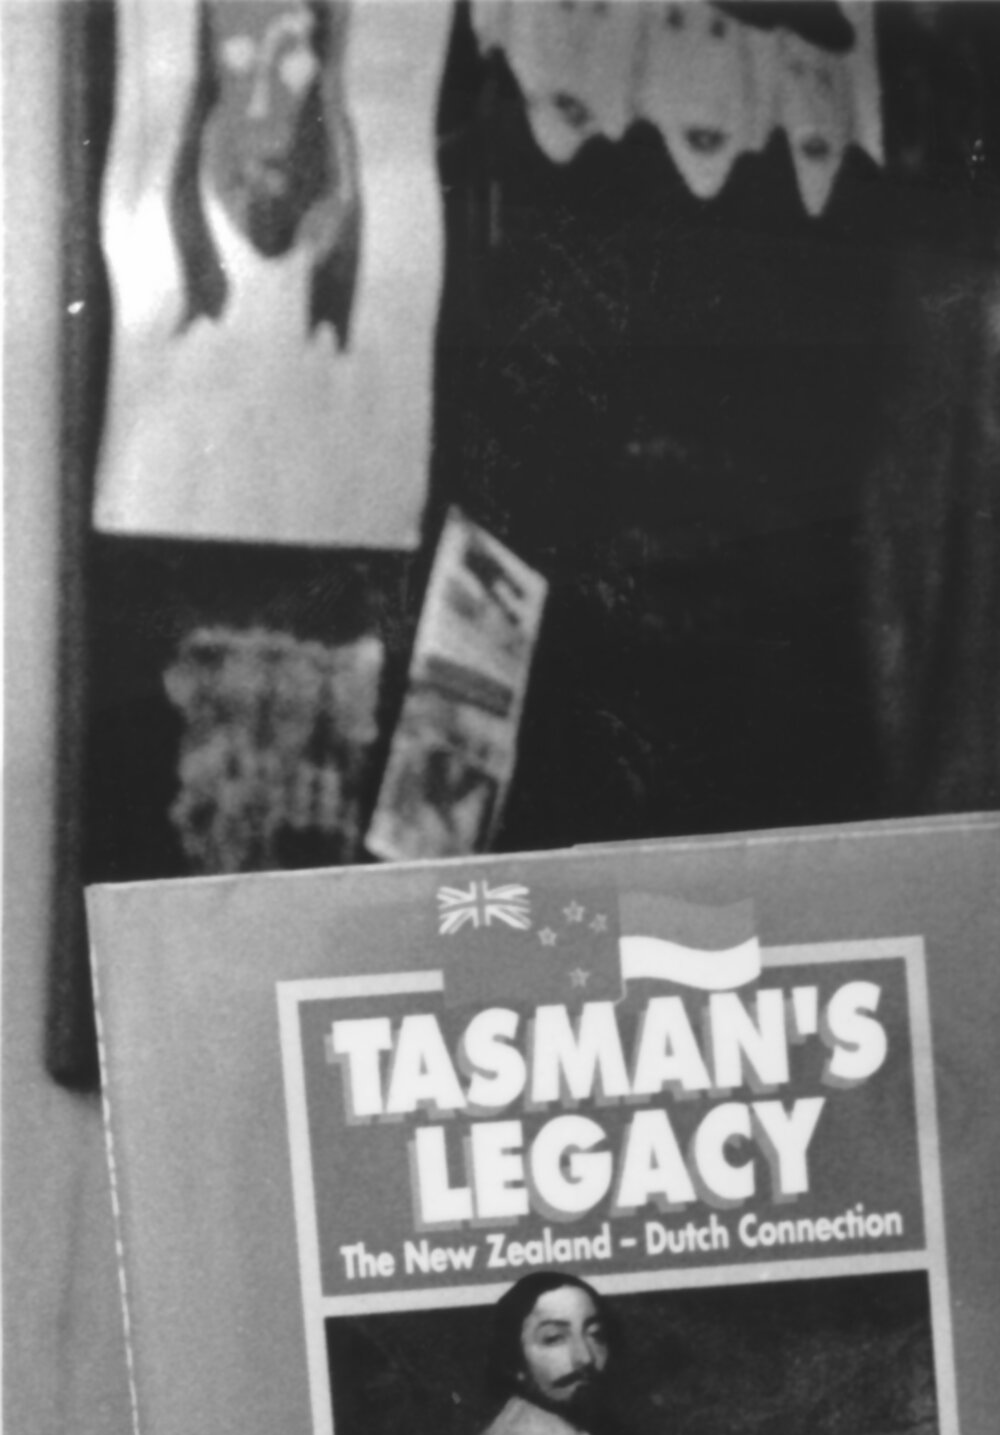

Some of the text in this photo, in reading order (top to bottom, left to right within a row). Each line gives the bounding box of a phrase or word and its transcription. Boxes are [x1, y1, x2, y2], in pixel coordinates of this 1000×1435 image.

[330, 980, 888, 1118] TASMAN'S
[414, 1096, 825, 1224] LEGACY
[340, 1243, 395, 1280] The
[404, 1238, 476, 1274] New
[486, 1226, 612, 1268] Zealand
[646, 1214, 729, 1255] Dutch
[738, 1203, 903, 1247] Connection
